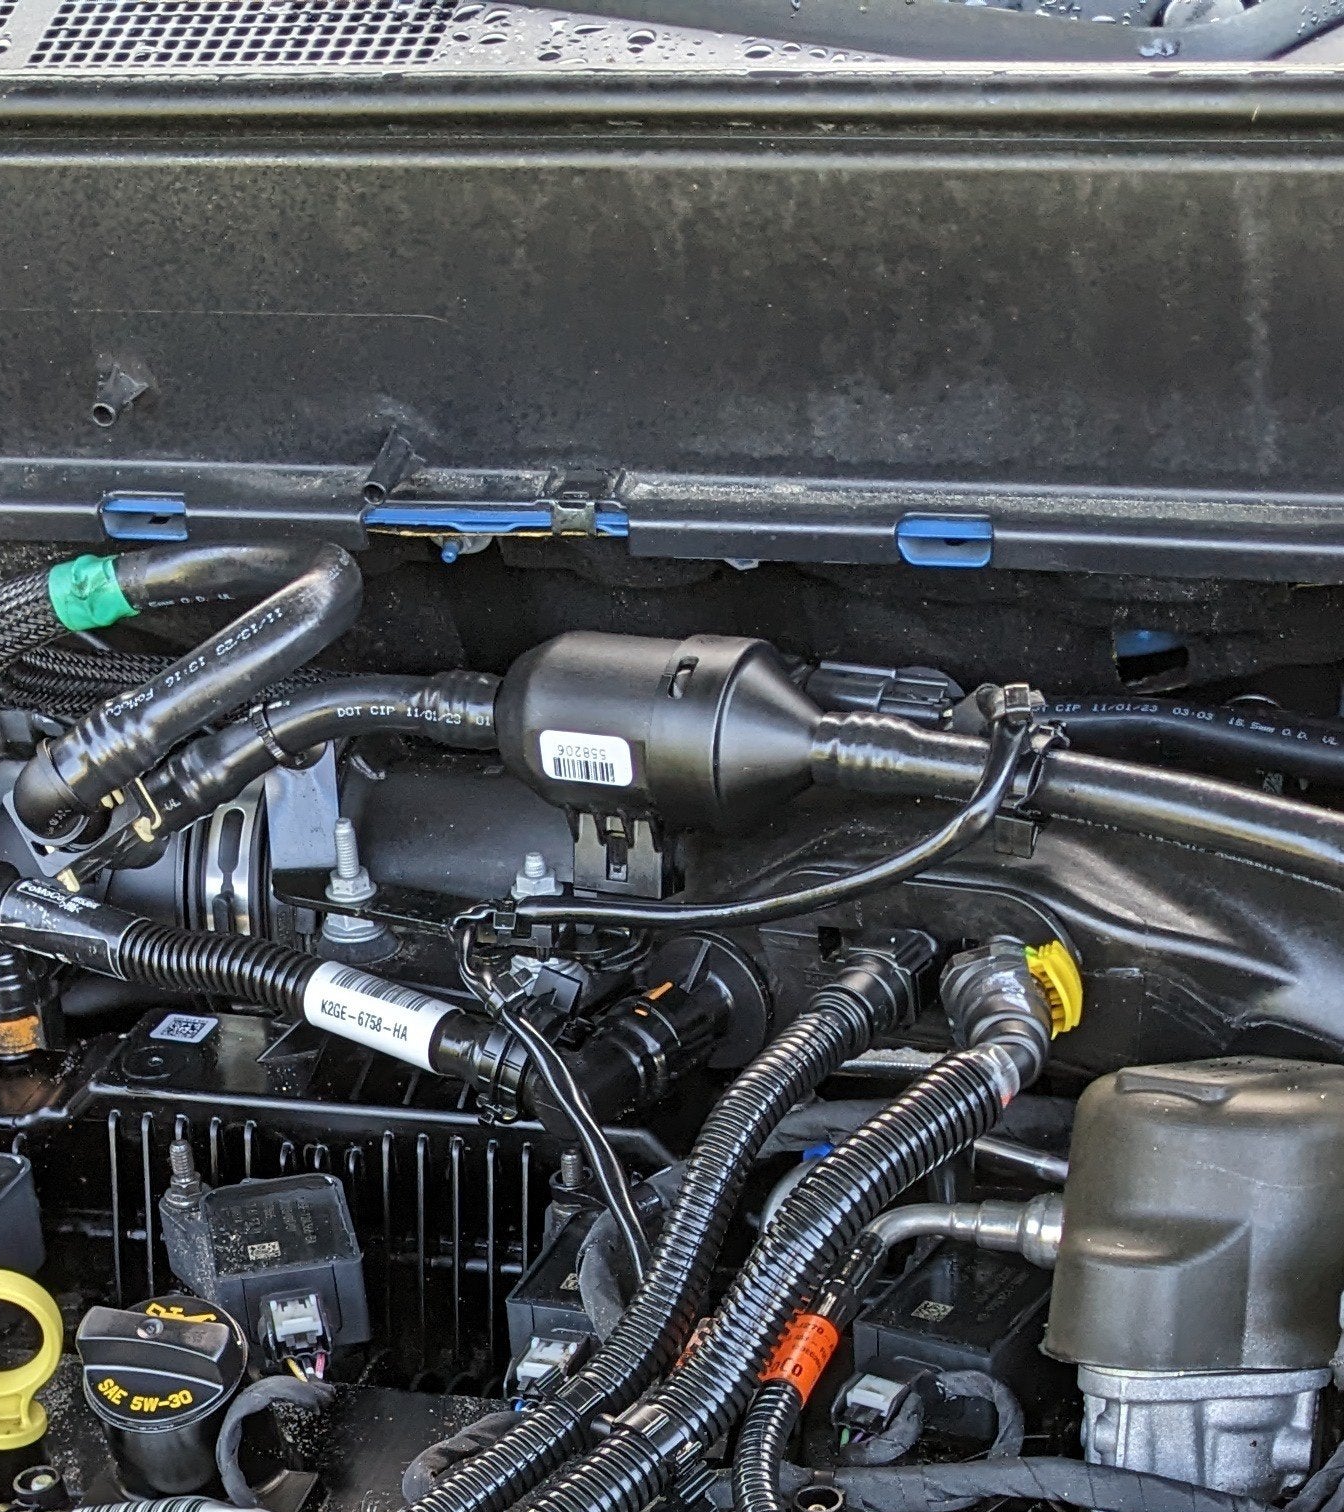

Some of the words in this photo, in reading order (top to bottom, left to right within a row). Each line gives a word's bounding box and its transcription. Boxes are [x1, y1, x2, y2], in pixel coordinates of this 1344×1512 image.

[336, 706, 362, 719] DOT
[369, 705, 395, 717] CIP
[406, 707, 462, 726] 11/01/23
[557, 744, 609, 761] 558206
[320, 997, 409, 1042] K2GE-6758-HA
[97, 1378, 129, 1406] SAE
[130, 1389, 194, 1412] 5W-30
